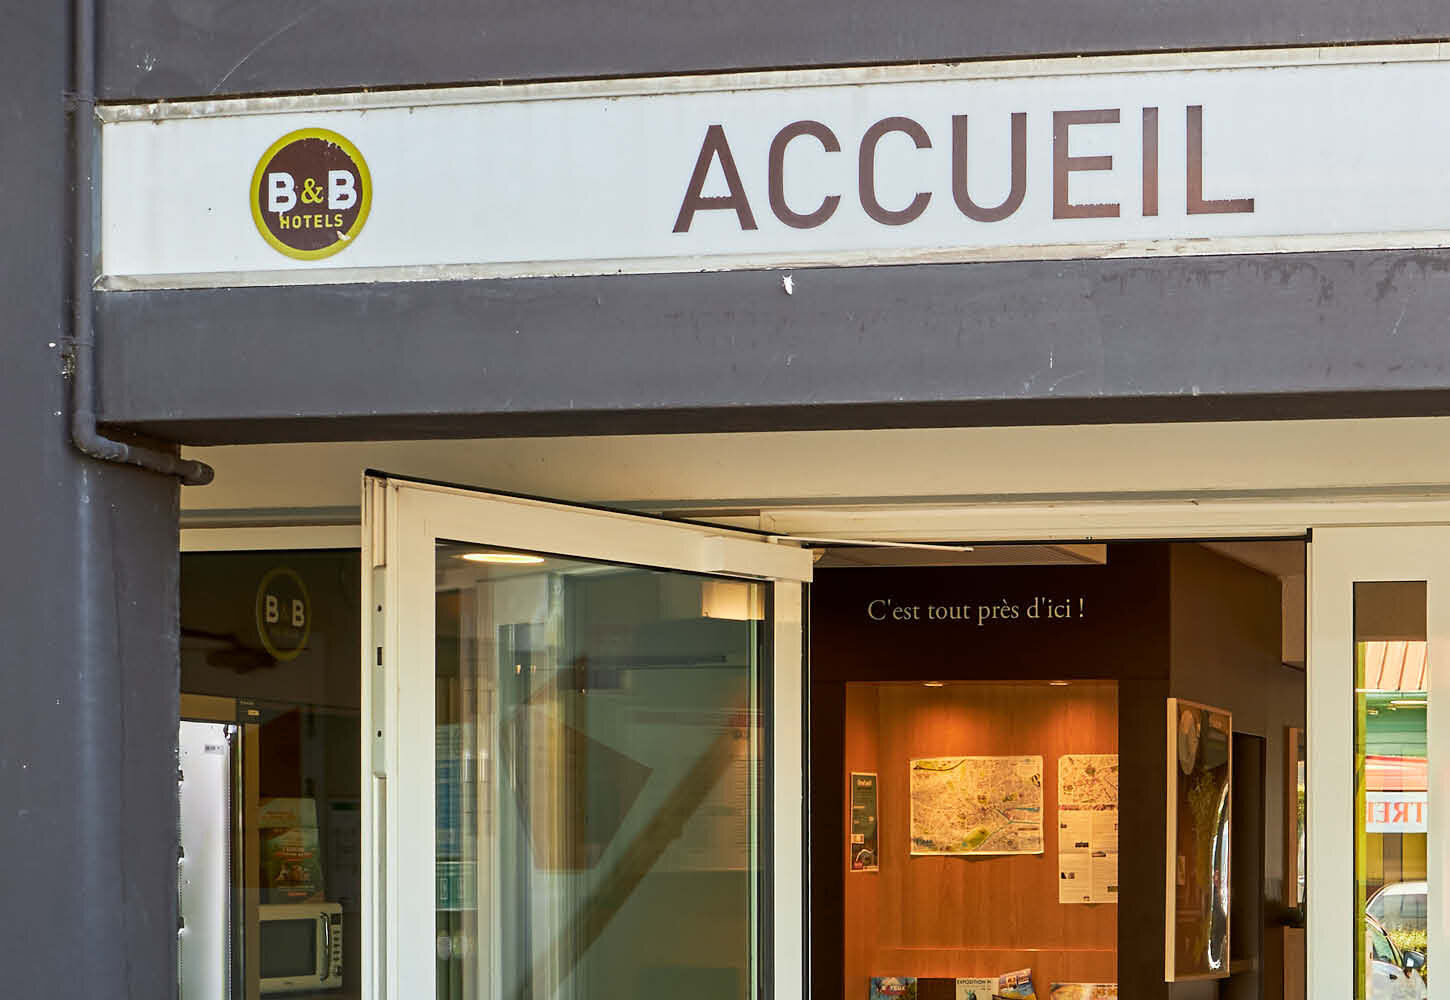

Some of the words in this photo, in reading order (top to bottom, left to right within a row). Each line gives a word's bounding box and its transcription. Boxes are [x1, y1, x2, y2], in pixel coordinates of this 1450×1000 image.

[672, 103, 1256, 234] ACCUEIL
[268, 169, 357, 212] B&B
[279, 213, 344, 230] HOTELS
[867, 598, 920, 621] C'est
[927, 601, 970, 620] tout
[977, 598, 1020, 625] près
[1026, 597, 1072, 620] d'ici
[1078, 598, 1085, 618] !
